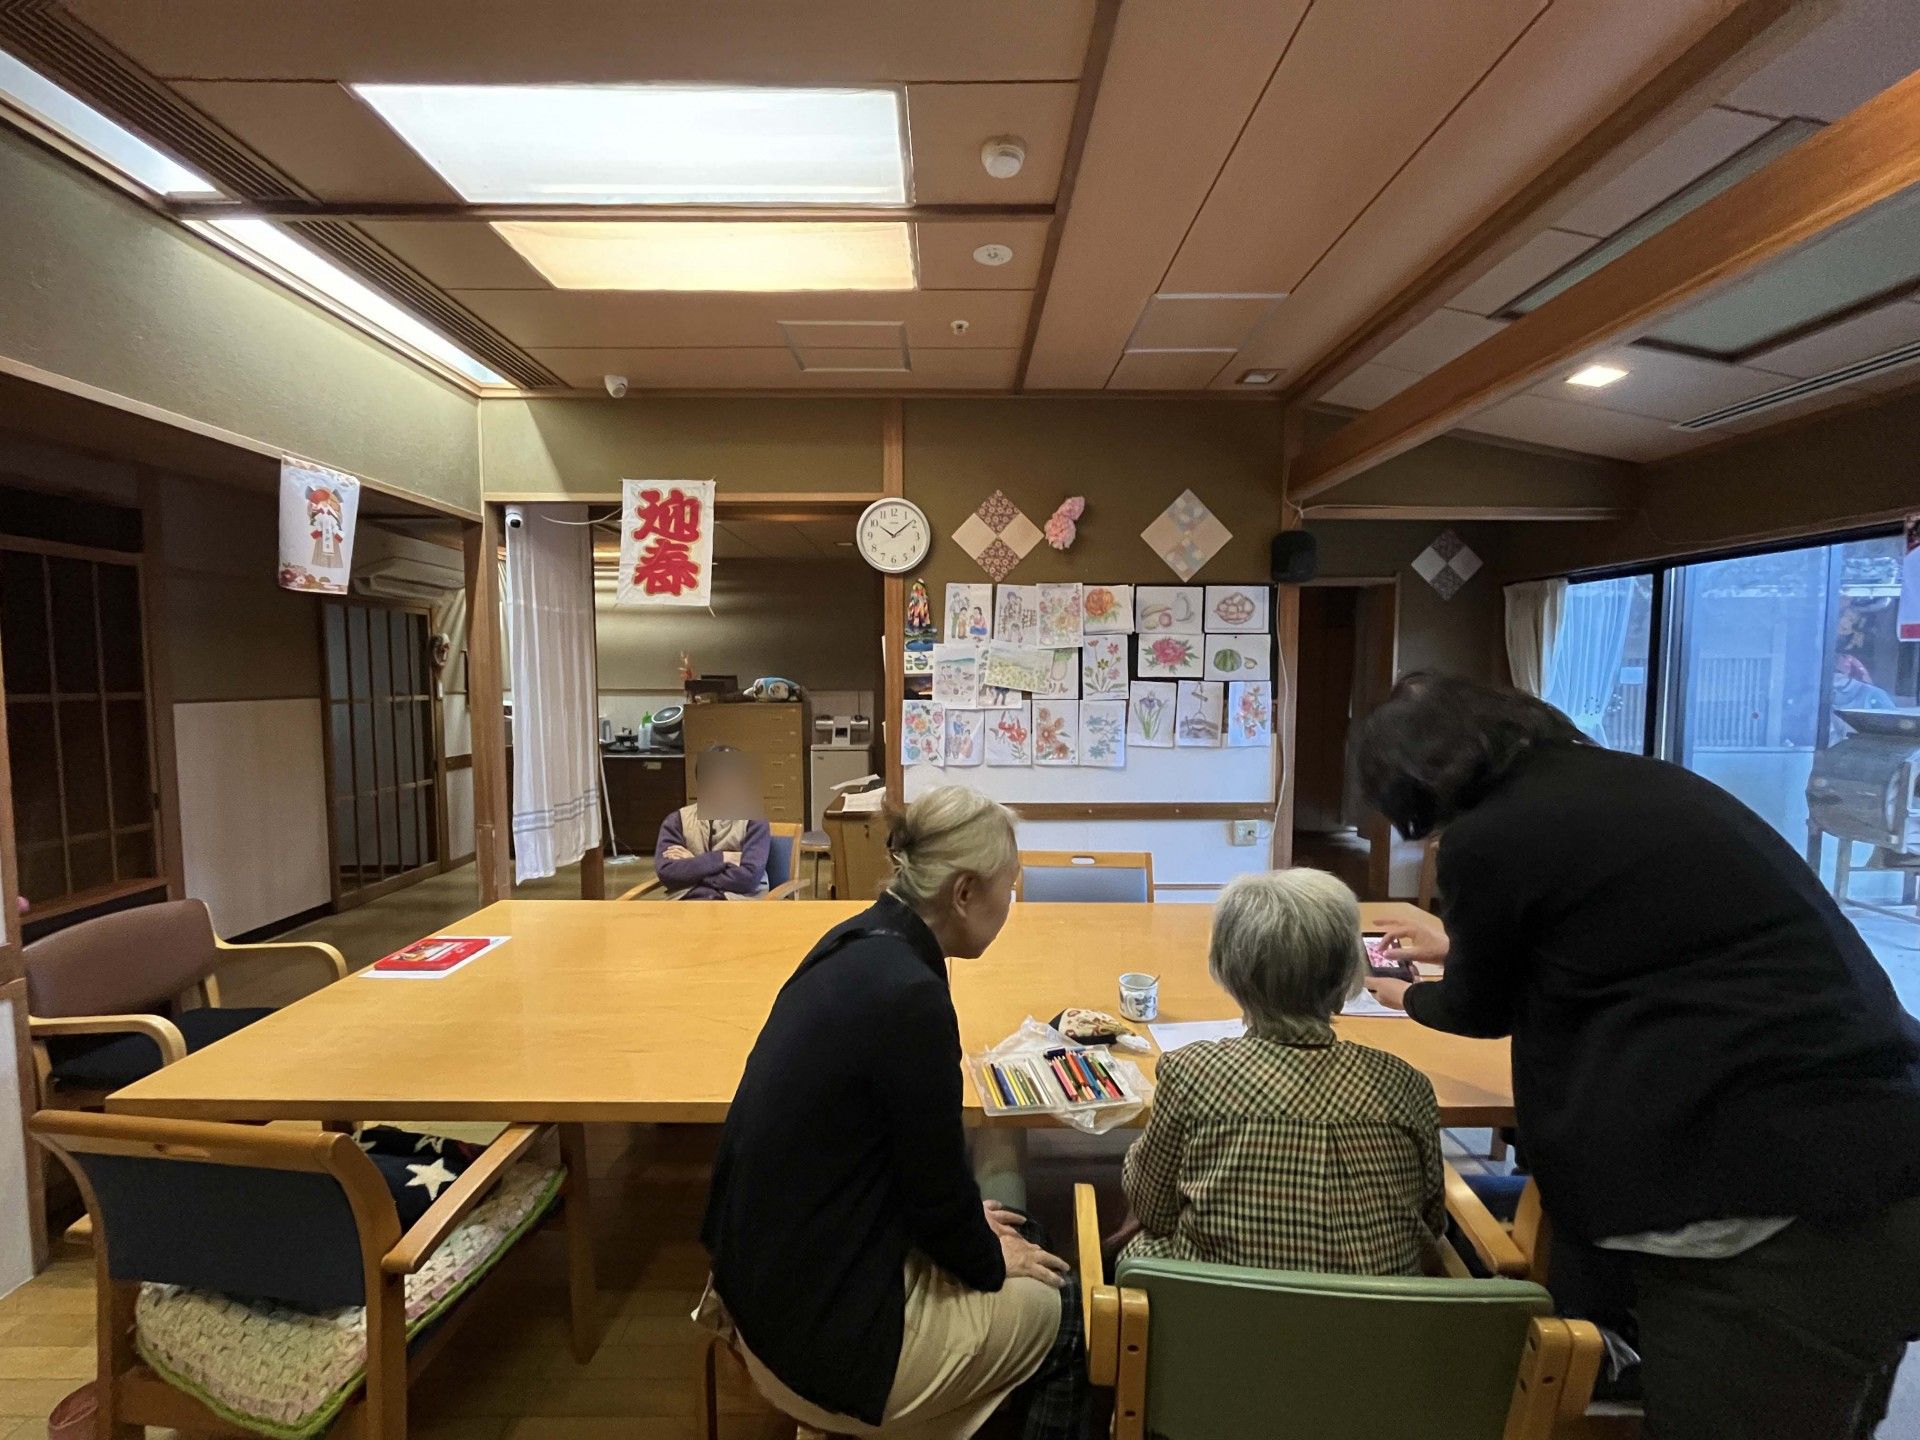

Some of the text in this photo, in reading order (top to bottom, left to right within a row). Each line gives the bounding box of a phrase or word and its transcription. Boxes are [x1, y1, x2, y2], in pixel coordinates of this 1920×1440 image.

[880, 510, 886, 519] 11
[890, 508, 898, 517] 12
[870, 519, 879, 527] 10
[911, 519, 917, 528] 2
[867, 531, 873, 540] 9
[915, 531, 920, 540] 3
[632, 488, 700, 595] 迎春
[871, 544, 877, 552] 8
[910, 545, 916, 553] 4
[880, 553, 886, 561] 7
[891, 555, 897, 564] 6
[903, 553, 908, 561] 5
